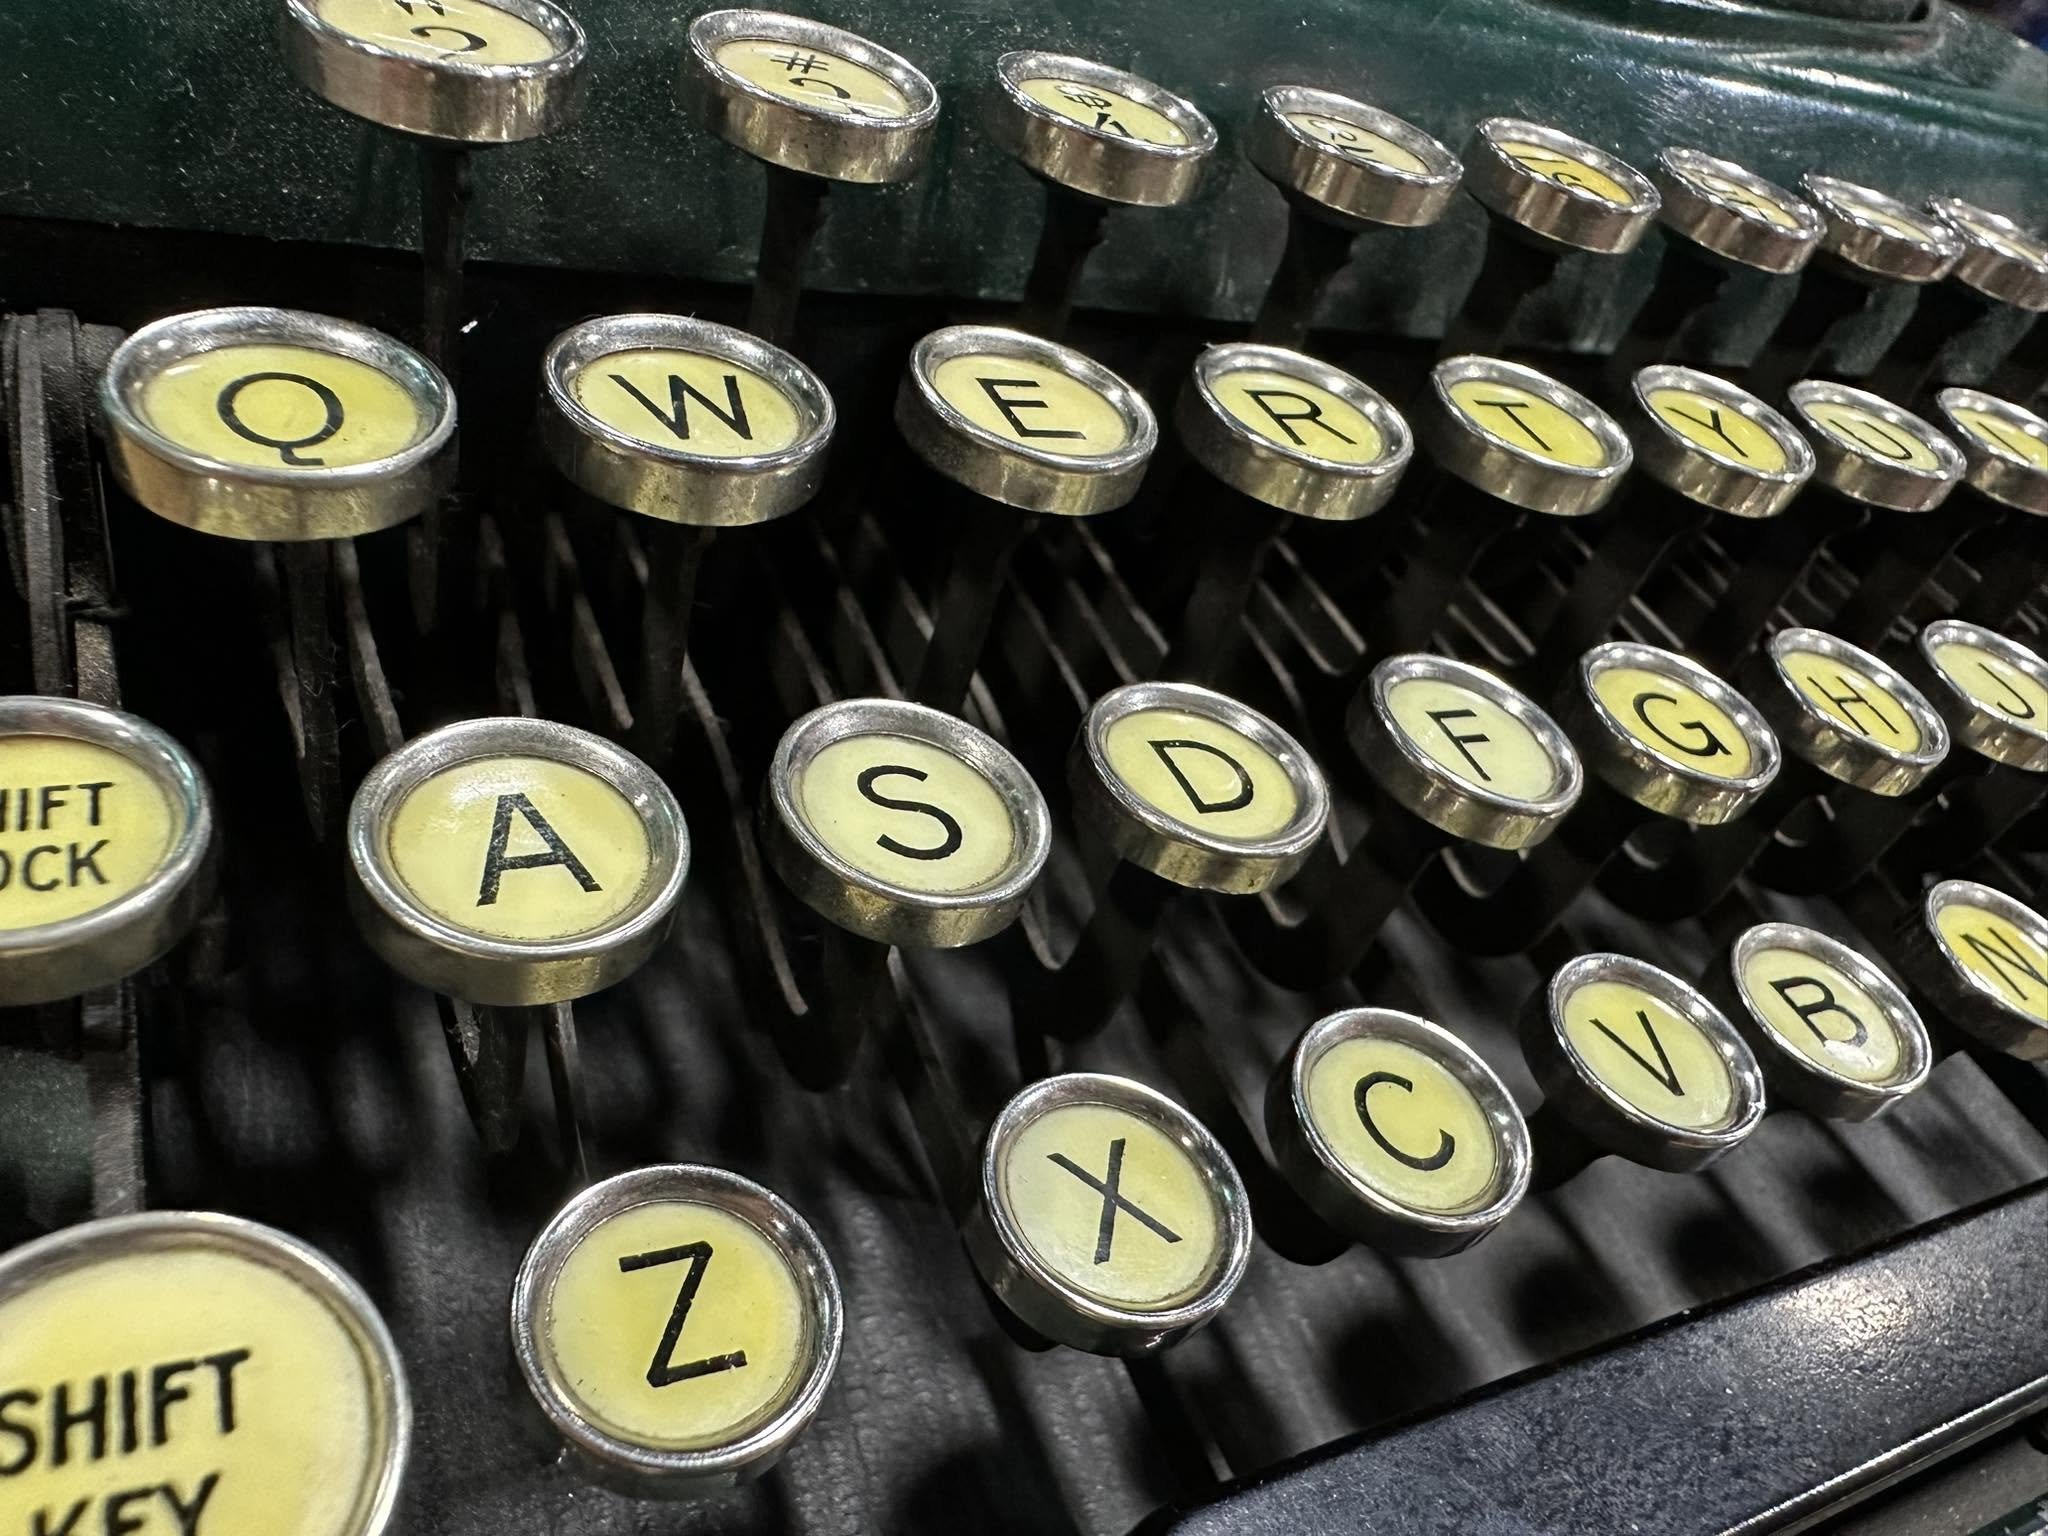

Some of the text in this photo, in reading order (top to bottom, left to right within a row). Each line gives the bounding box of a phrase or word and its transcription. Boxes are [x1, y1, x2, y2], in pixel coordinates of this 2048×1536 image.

[217, 372, 344, 466] Q
[608, 374, 753, 440] W
[976, 377, 1087, 439] E
[1243, 389, 1358, 446] R
[1473, 399, 1553, 452] T
[1665, 407, 1749, 457] Y
[1828, 418, 1914, 461] U
[1632, 692, 1732, 757] G
[1807, 675, 1900, 736] H
[1977, 662, 2035, 719] J
[1147, 740, 1255, 814] D
[1425, 708, 1492, 782] F
[857, 764, 962, 861] S
[475, 792, 603, 907] A
[1960, 927, 2048, 1000] N
[1768, 976, 1866, 1048] B
[1589, 1010, 1686, 1097] V
[1353, 1070, 1456, 1172] C
[1046, 1138, 1183, 1266] X
[618, 1240, 748, 1389] Z
[0, 1348, 251, 1478] SHIFT
